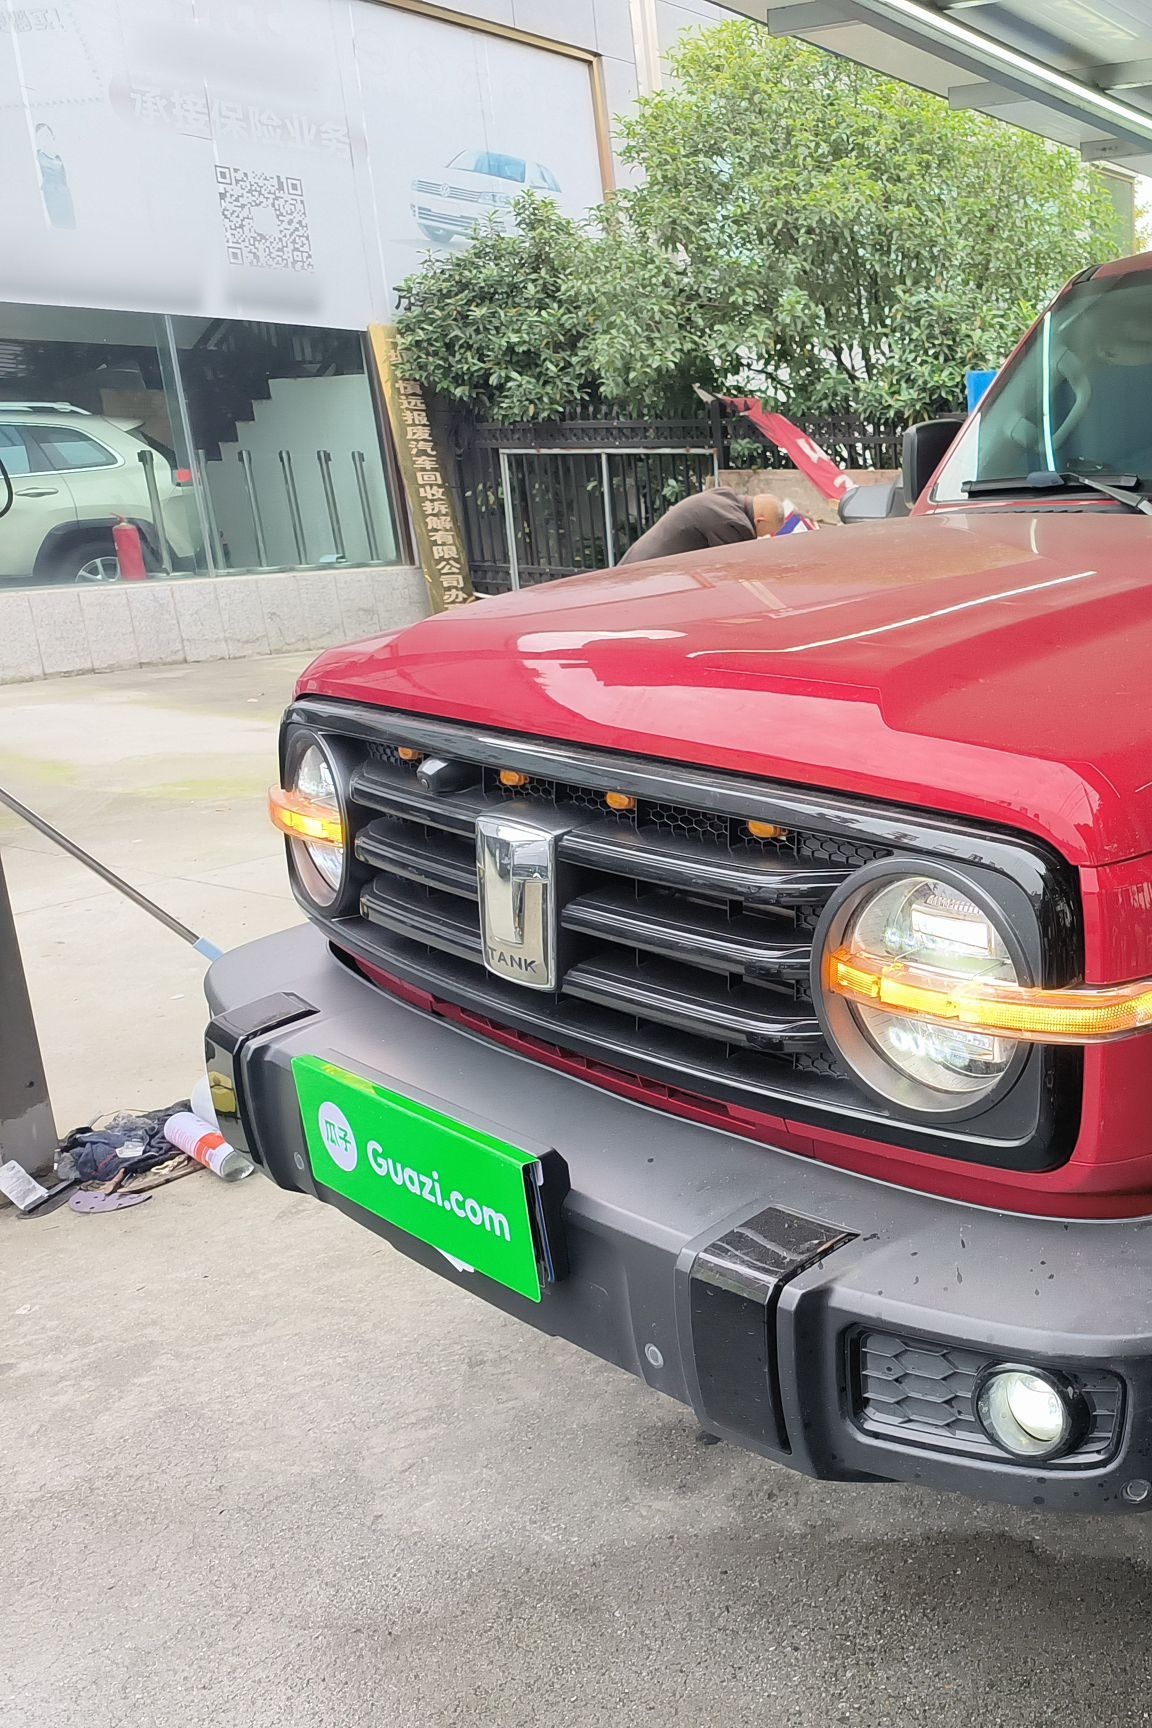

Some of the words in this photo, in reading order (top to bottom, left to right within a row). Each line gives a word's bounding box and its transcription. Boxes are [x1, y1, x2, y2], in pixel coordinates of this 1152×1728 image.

[130, 88, 350, 154] 承接保险业务
[487, 946, 537, 974] TANK
[323, 1120, 352, 1153] 瓜子
[366, 1139, 512, 1242] Guazi.com
